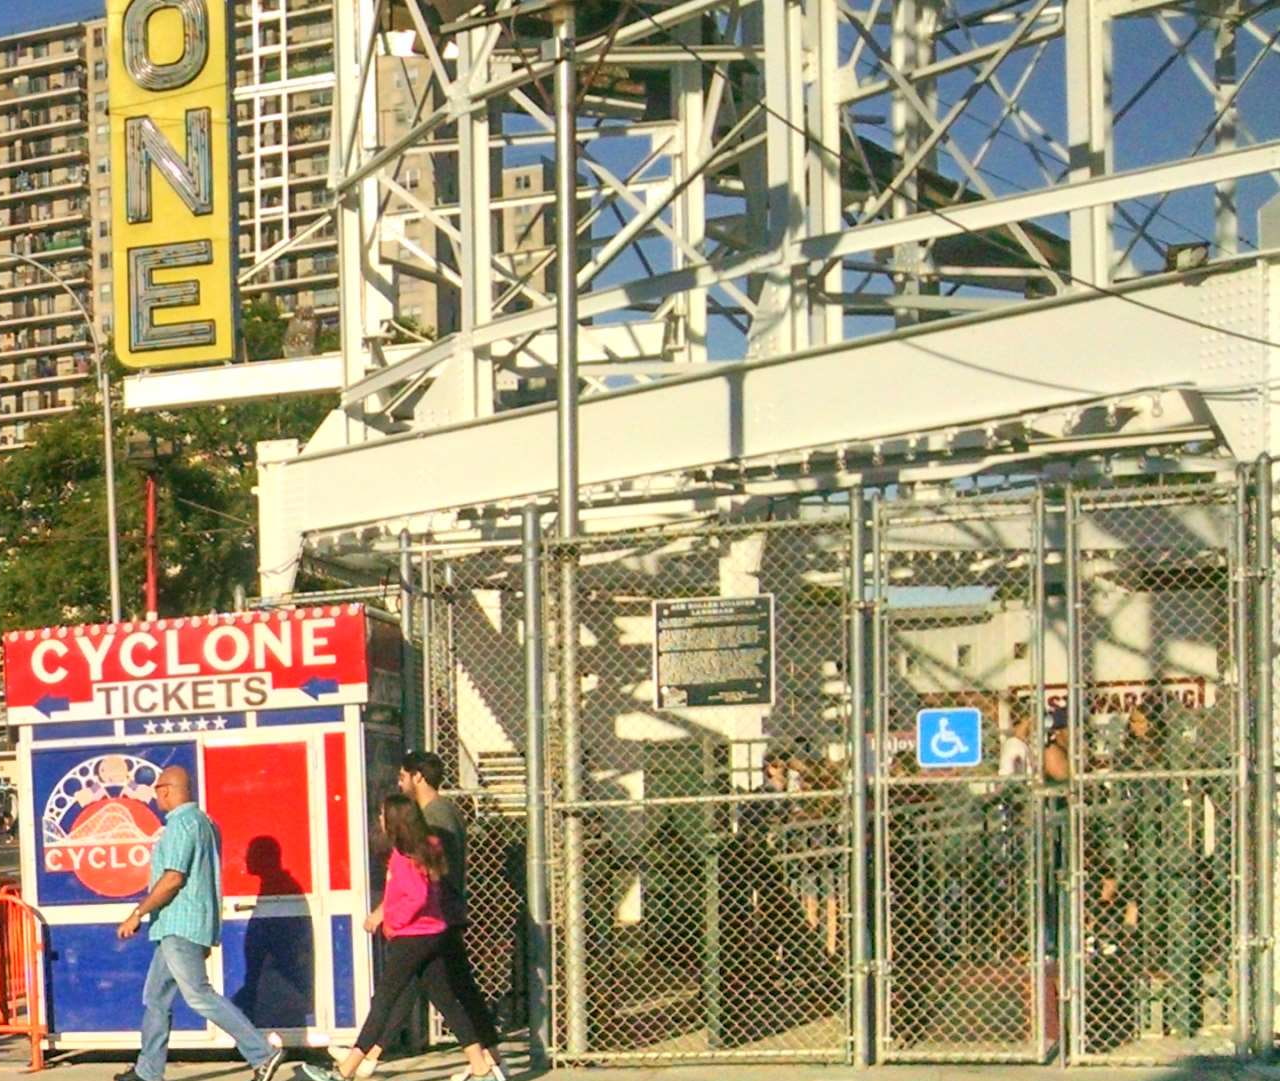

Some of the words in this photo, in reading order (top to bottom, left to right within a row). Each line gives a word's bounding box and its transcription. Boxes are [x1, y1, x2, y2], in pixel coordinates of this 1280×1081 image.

[122, 0, 217, 354] ONE
[31, 618, 336, 684] CYCLONE
[96, 676, 268, 715] TICKETS
[1090, 688, 1195, 714] WARNG
[45, 845, 153, 871] CYCLO
